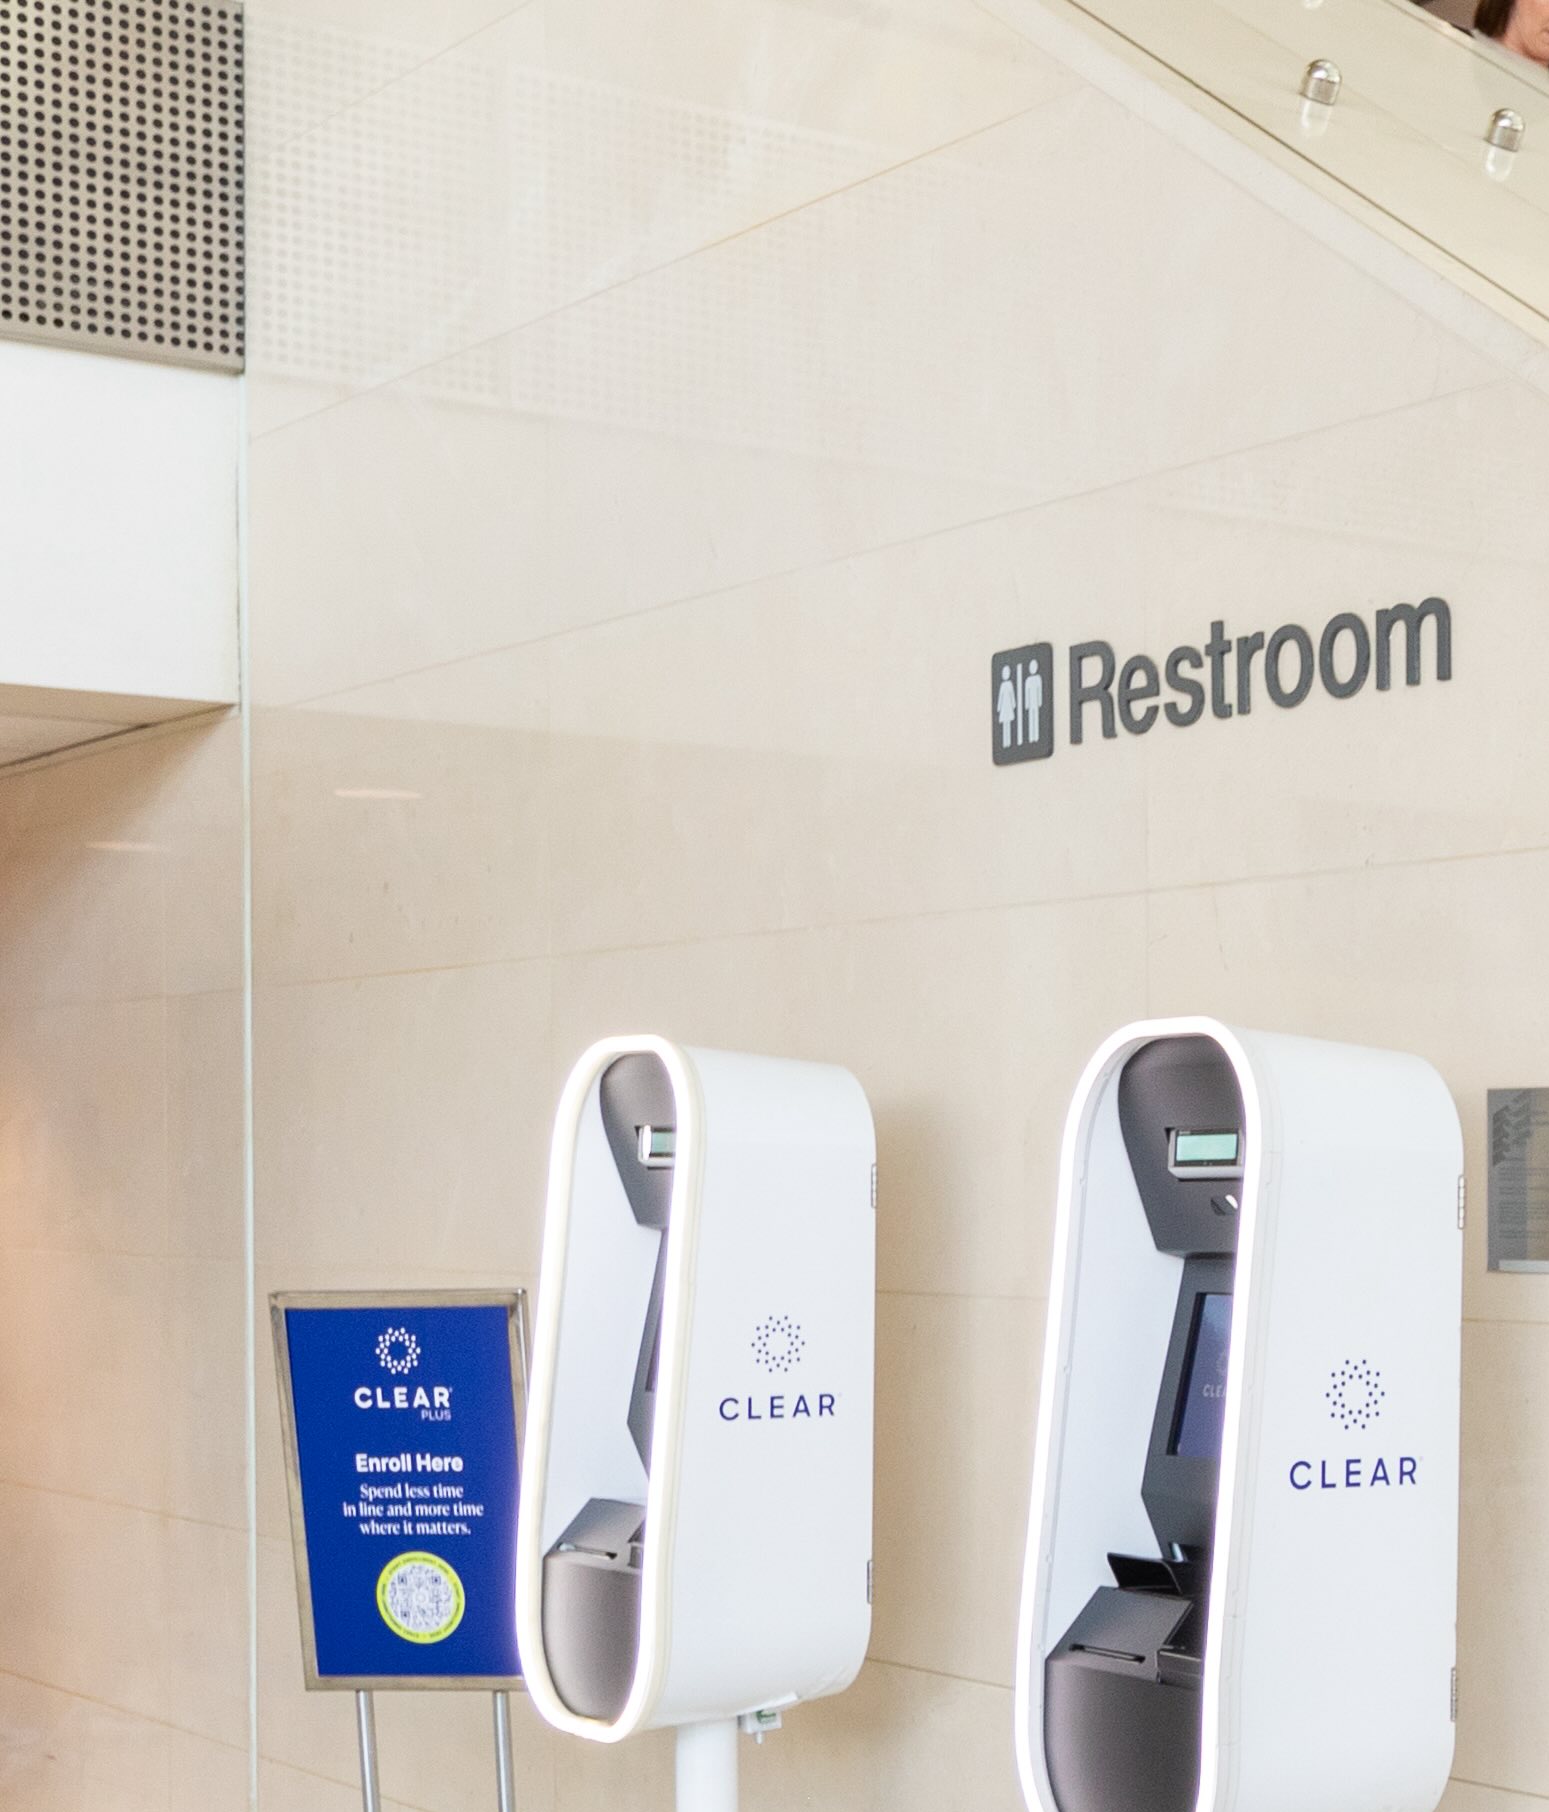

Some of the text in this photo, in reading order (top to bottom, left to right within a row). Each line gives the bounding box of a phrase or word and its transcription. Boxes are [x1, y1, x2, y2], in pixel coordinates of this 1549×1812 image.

[1068, 596, 1453, 745] Restroom
[421, 1410, 452, 1421] PLUS
[719, 1393, 835, 1421] CLEAR
[356, 1453, 463, 1473] Enroll Here
[1289, 1456, 1417, 1490] CLEAR
[360, 1483, 464, 1501] Spend less time
[343, 1501, 484, 1517] in line and more time
[359, 1519, 471, 1536] where it matters.
